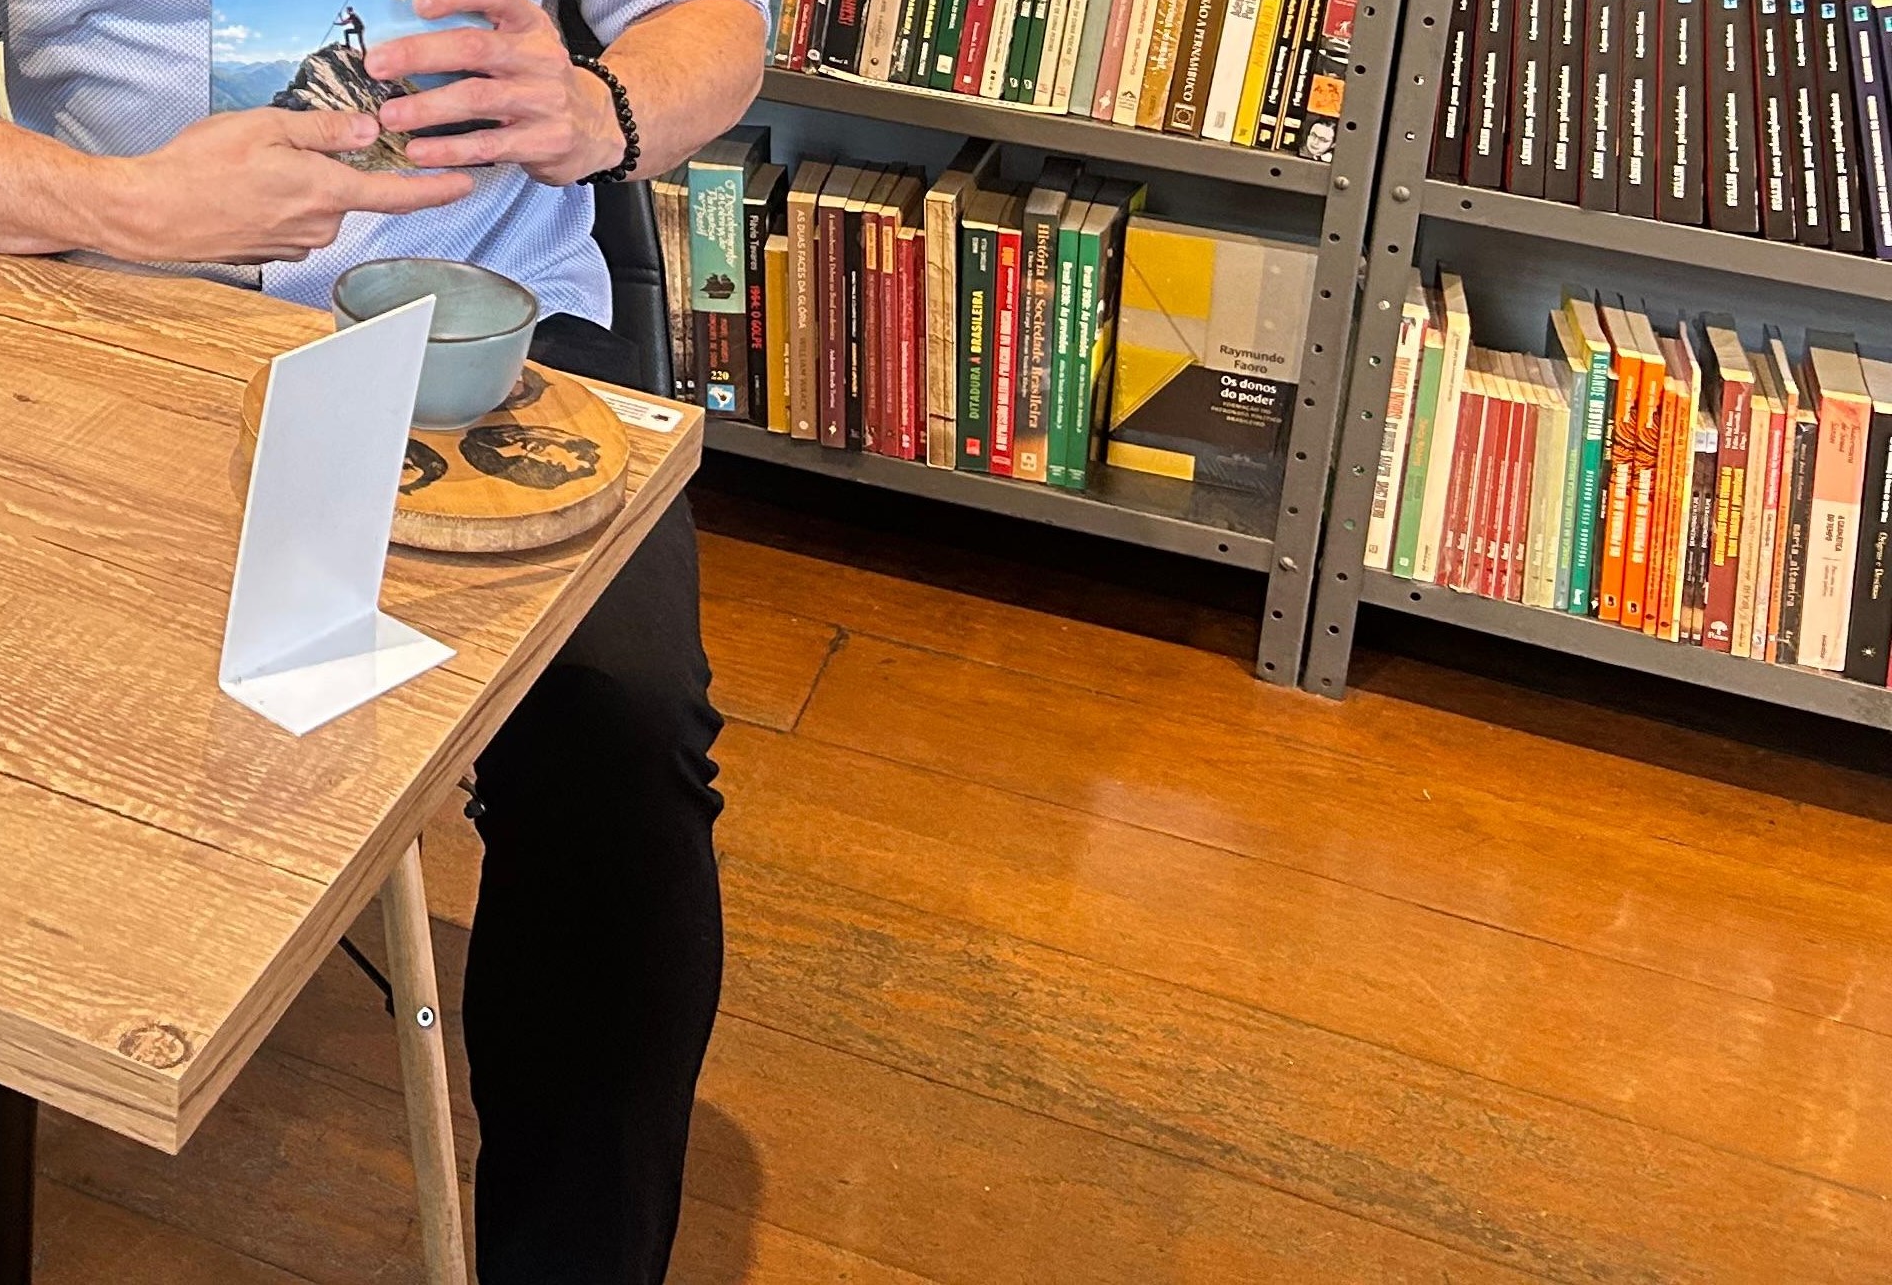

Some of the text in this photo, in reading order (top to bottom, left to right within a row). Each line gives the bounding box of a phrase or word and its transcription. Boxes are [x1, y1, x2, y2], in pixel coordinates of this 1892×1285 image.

[1195, 20, 1207, 28] A
[1181, 29, 1206, 102] PERNAMBUCO
[750, 215, 759, 238] Flávio
[750, 240, 759, 271] Tavares
[750, 285, 759, 309] 1964:
[969, 290, 984, 353] BRASILEIRA
[1028, 223, 1049, 428] História da Sociedade Brasileira
[750, 319, 762, 349] GOLPE
[1220, 344, 1285, 365] Raymundo
[710, 371, 730, 381] 220
[1234, 359, 1268, 375] Faoro
[968, 366, 982, 419] DITADURA
[1220, 388, 1275, 406] do poder
[1221, 376, 1277, 394] Os donos
[1786, 524, 1802, 607] maria_altamira
